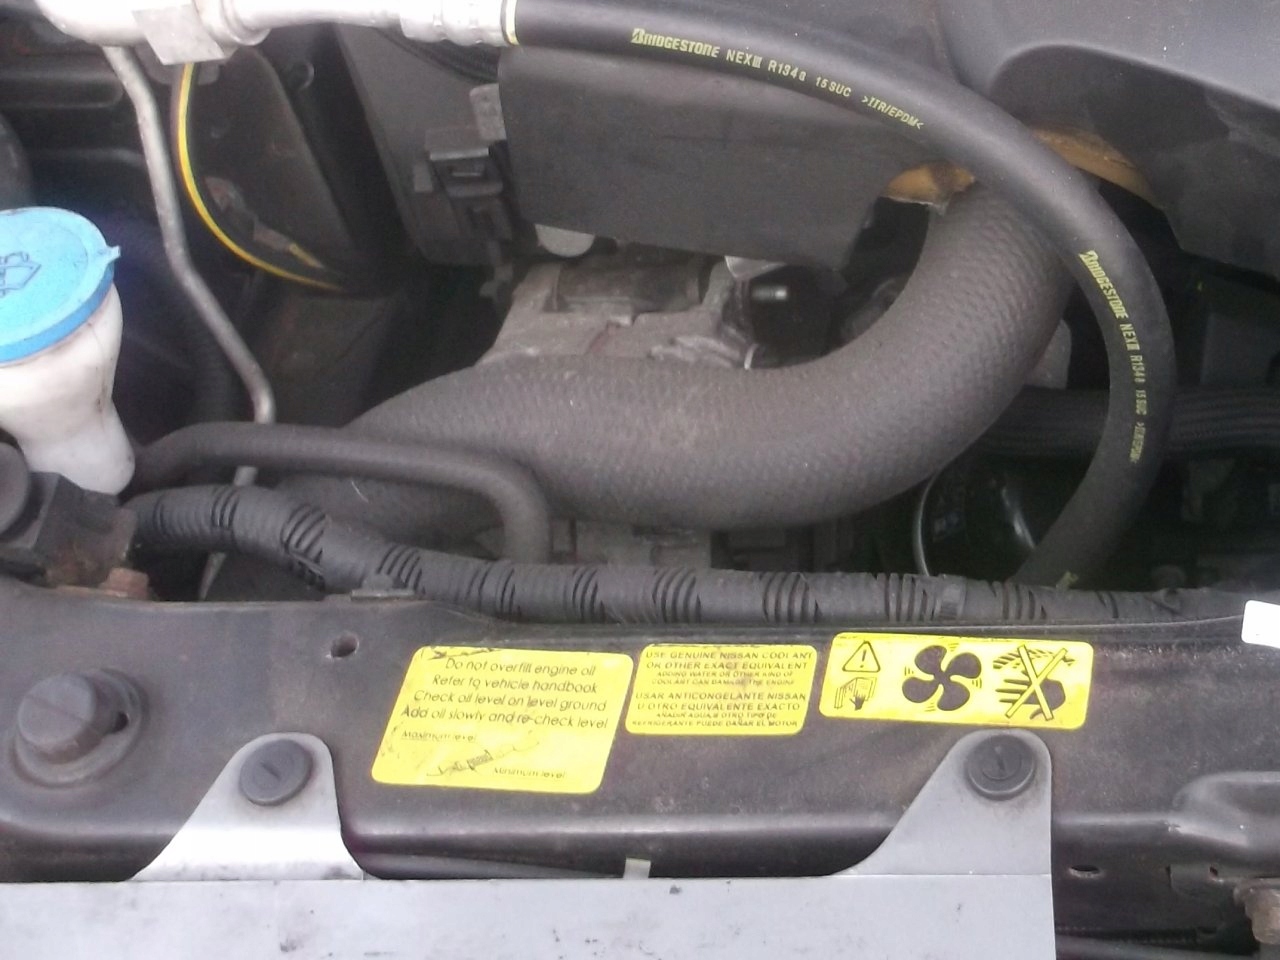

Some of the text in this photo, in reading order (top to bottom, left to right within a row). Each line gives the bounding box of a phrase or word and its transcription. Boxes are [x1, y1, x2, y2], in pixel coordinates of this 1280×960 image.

[631, 28, 720, 58] BRIDGESTONE
[1078, 249, 1130, 320] BRIDGESTONE
[646, 661, 661, 669] OR
[665, 661, 701, 669] OTHER
[670, 651, 716, 659] GENUINE
[720, 652, 759, 660] NISSAN
[445, 657, 596, 677] Do not overfill engine oil
[432, 674, 598, 693] Refer to vehicle handbook
[413, 689, 607, 712] Check oil level on level ground
[636, 692, 806, 700] USAR ANTICONGELANTE NISSAN
[401, 704, 609, 729] Add oil slowly and re-check level
[681, 703, 753, 711] EQUIVALENTE
[757, 703, 800, 711] EXACTO
[452, 733, 476, 742] evel
